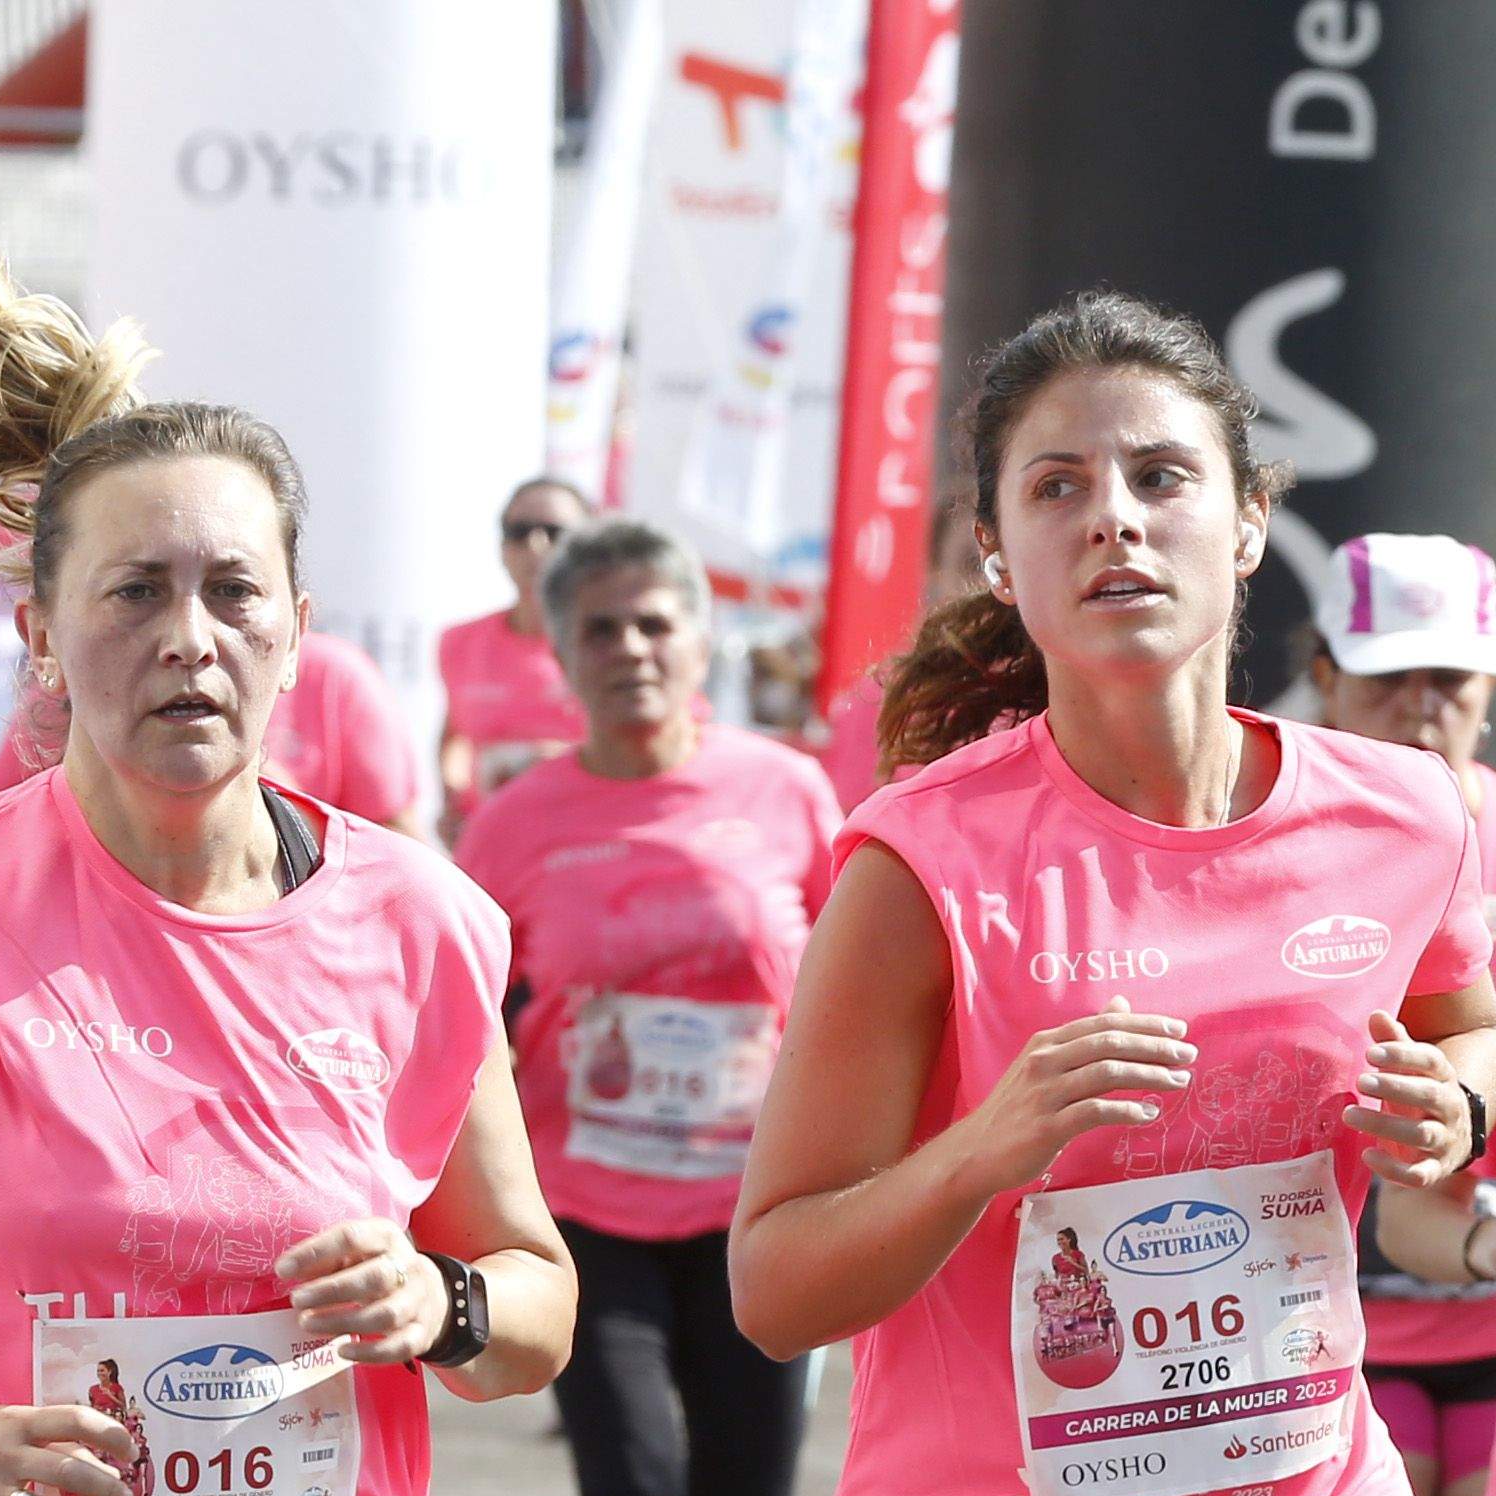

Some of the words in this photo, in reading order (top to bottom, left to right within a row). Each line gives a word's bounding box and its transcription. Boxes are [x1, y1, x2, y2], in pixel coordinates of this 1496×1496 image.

[175, 127, 496, 206] OYSHO
[1029, 947, 1170, 984] OYSHO
[1292, 940, 1385, 966] ASTURIANA
[23, 1017, 174, 1058] OYSHO
[1261, 1198, 1326, 1220] SUMA
[1278, 1187, 1325, 1202] DORSAL
[1115, 1227, 1241, 1264] ASTURIANA
[1137, 1226, 1187, 1239] CENTRAL
[1132, 1294, 1245, 1349] 016
[180, 1370, 231, 1379] CENTRAL
[233, 1367, 274, 1379] LECHER
[292, 1350, 335, 1371] SUMA
[1160, 1356, 1231, 1391] 2706
[156, 1373, 278, 1402] ASTURIANA
[1064, 1410, 1160, 1438] CARRERA
[1164, 1404, 1191, 1424] DE
[1196, 1400, 1221, 1418] LA
[1224, 1388, 1289, 1413] MUJER
[1295, 1378, 1337, 1402] 2023
[164, 1445, 274, 1494] 016
[1062, 1452, 1167, 1487] OYSHO
[1250, 1419, 1336, 1455] Santander
